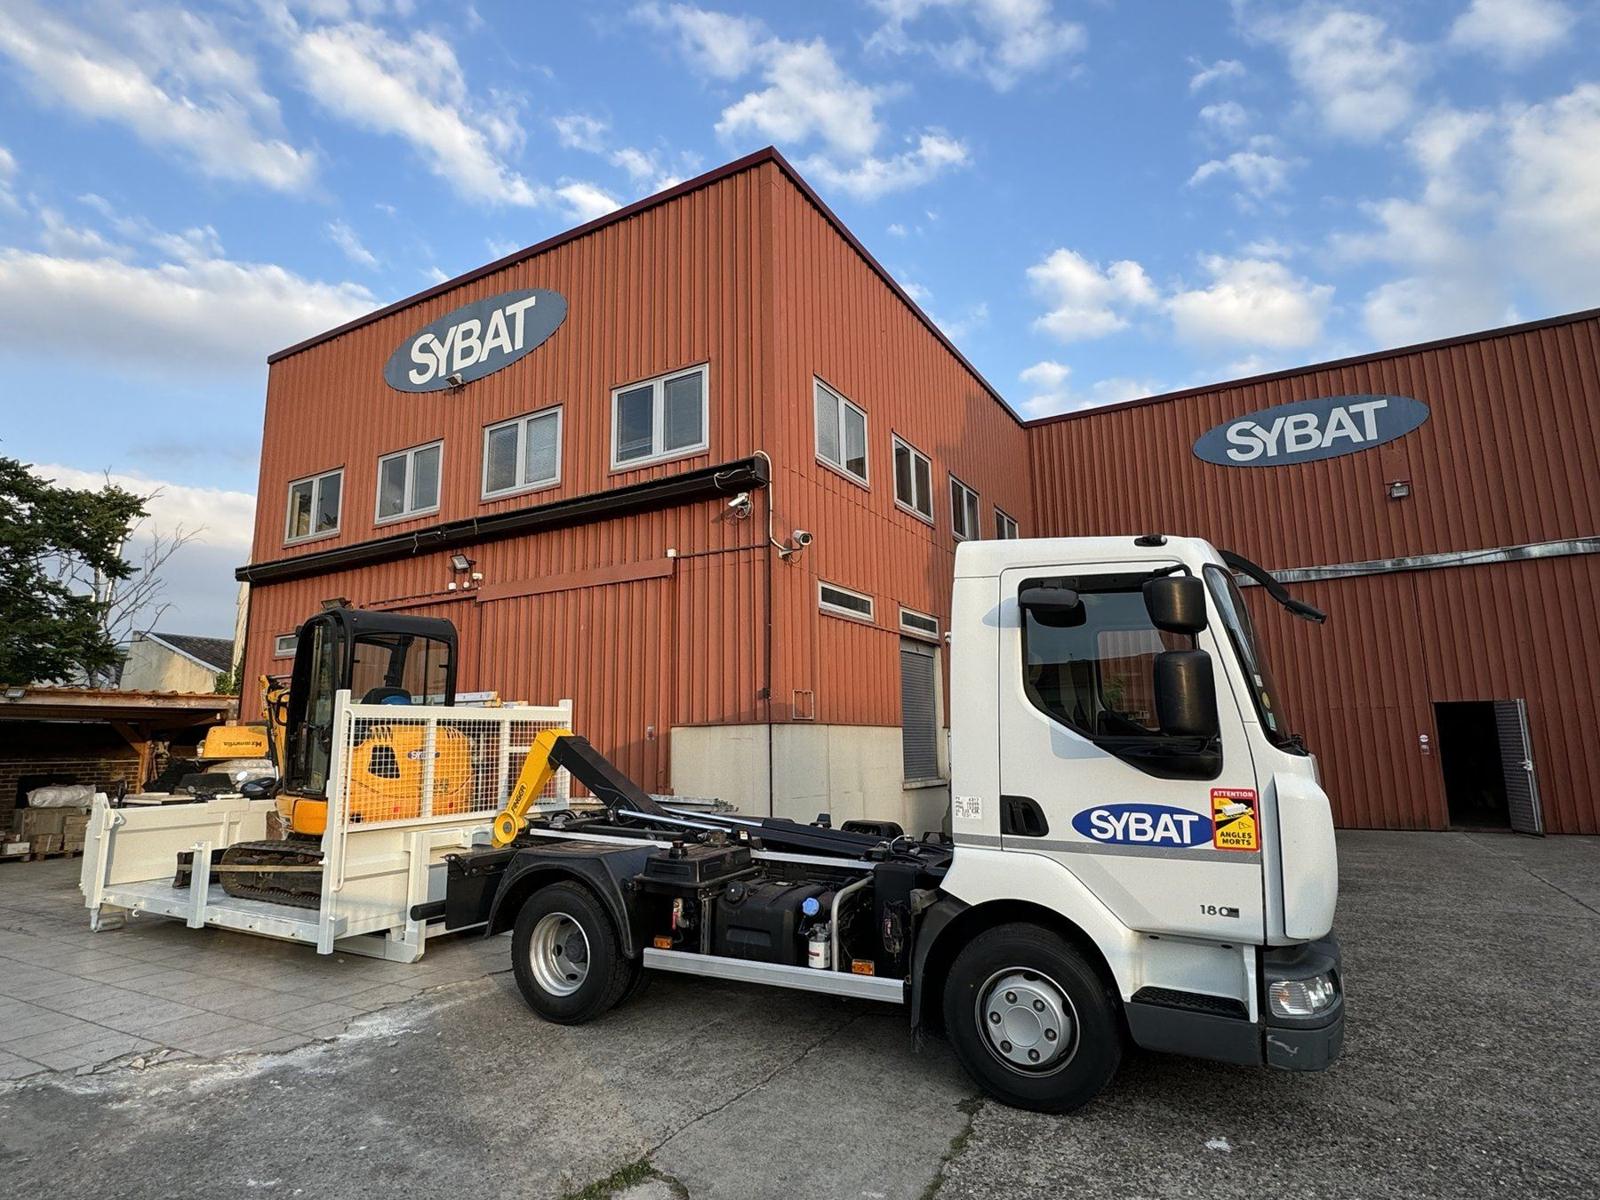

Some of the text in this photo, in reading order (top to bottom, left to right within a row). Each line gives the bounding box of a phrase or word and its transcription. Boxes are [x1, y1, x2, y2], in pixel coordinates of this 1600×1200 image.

[408, 295, 536, 385] SYBAT
[1226, 399, 1388, 462] SYBAT
[1213, 790, 1254, 798] ATTENTION
[1090, 809, 1199, 844] SYBAT
[1220, 831, 1252, 839] ANGLES
[1222, 838, 1252, 846] MORTS
